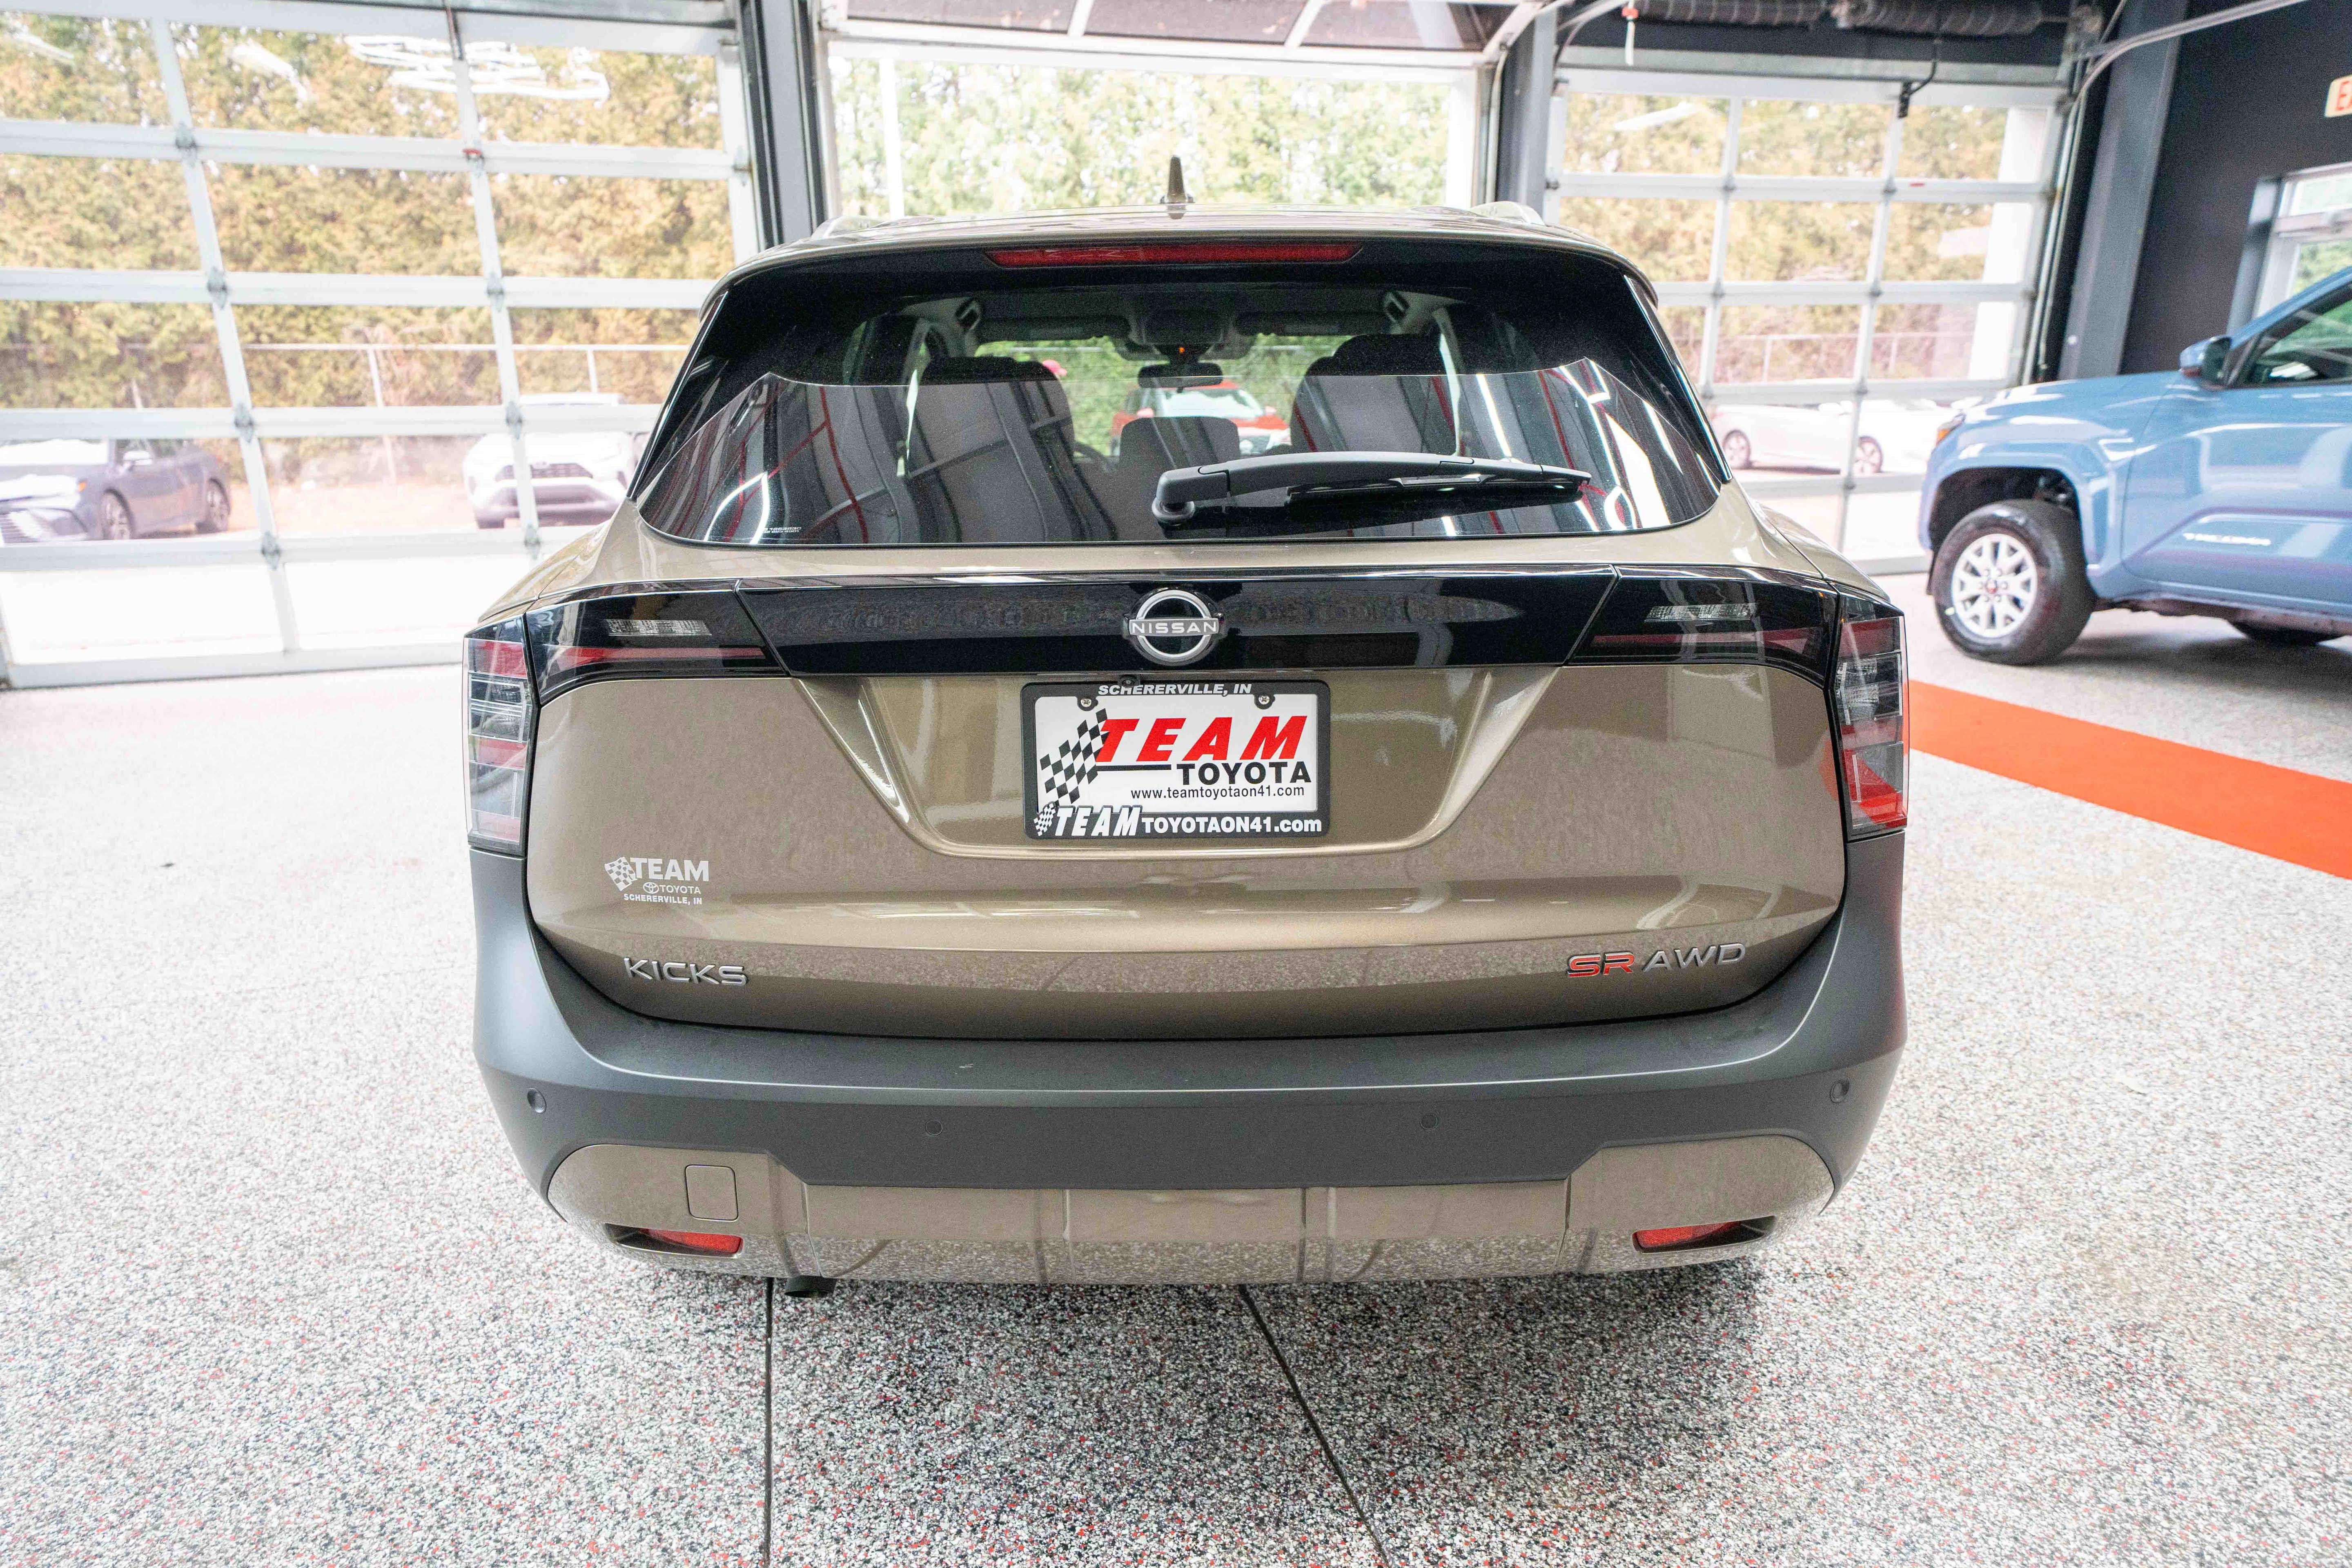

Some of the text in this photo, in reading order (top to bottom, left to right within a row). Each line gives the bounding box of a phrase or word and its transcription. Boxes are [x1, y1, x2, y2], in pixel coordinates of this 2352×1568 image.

[1132, 621, 1216, 634] NISSAN
[1098, 683, 1252, 696] SCHERERVILLE, IN
[1096, 715, 1307, 762] TEAM
[1176, 761, 1312, 785] TOYOTA
[1131, 784, 1305, 800] www.teamtoyotaon41.com
[1055, 806, 1322, 837] TEAM TOYOTAON41.com
[630, 857, 709, 882] TEAM
[624, 893, 690, 905] SCHERERVILLE,
[659, 884, 701, 894] TOYOTA
[624, 957, 748, 986] KICKS
[1567, 942, 1746, 978] SR AWD
